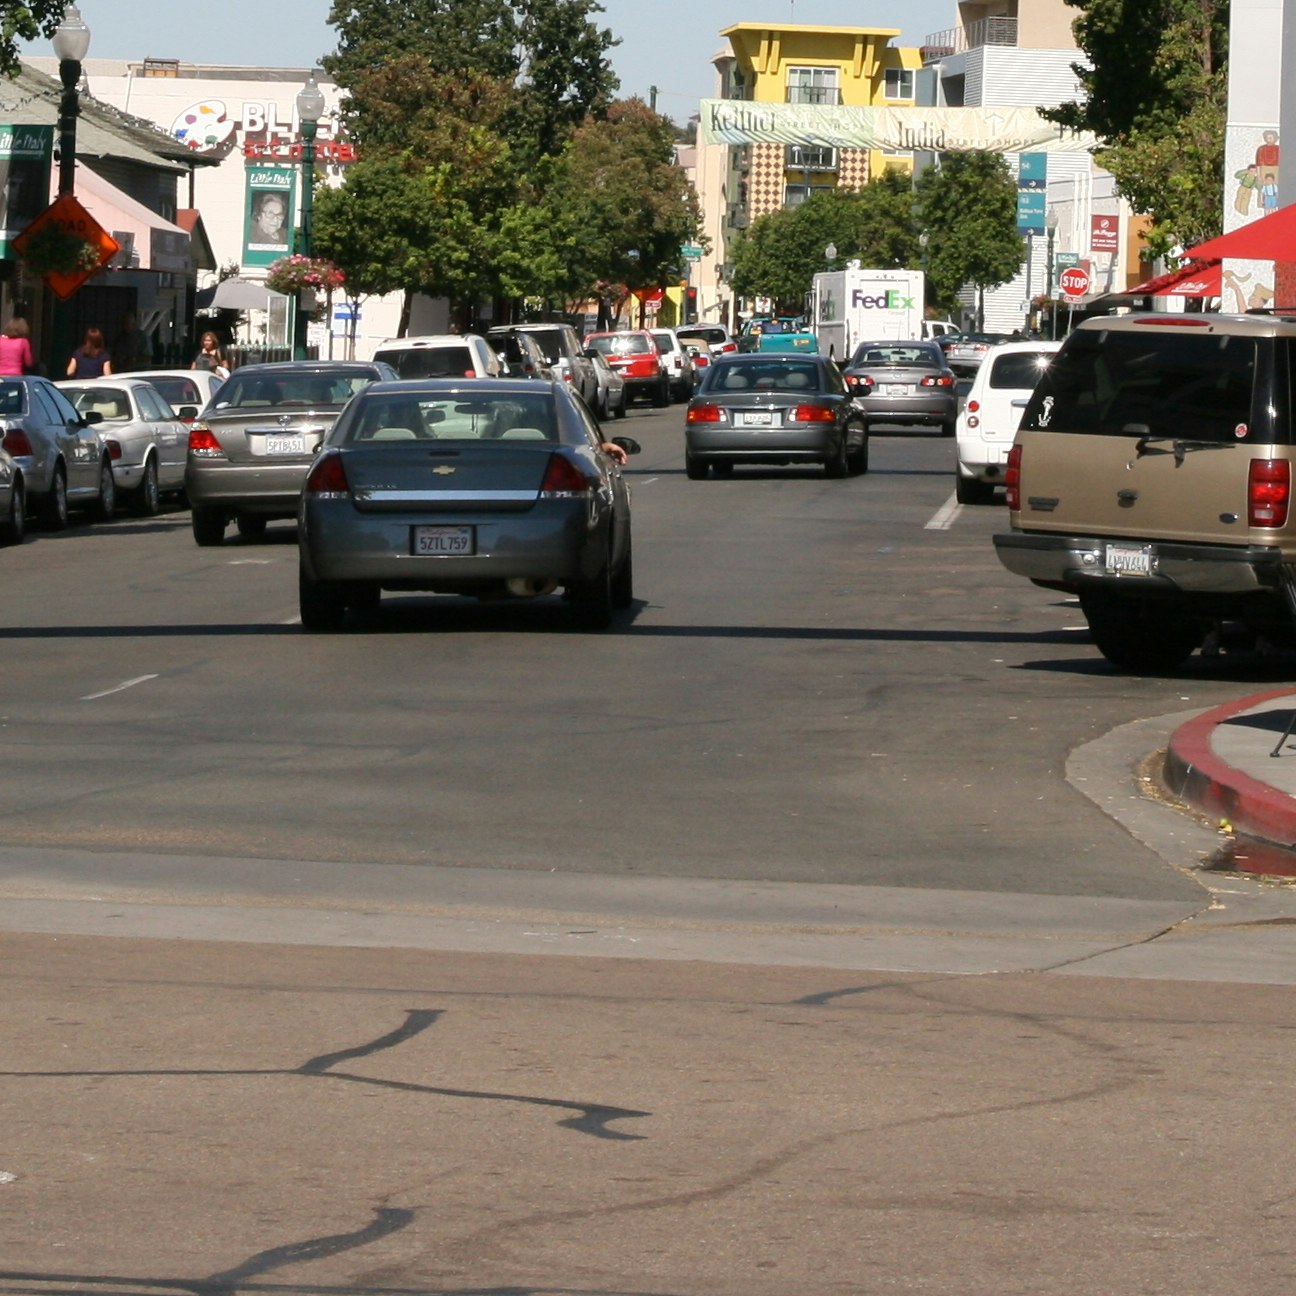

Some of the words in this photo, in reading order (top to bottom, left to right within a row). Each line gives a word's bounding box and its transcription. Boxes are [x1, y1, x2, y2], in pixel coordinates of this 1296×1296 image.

[897, 121, 947, 149] India
[1061, 276, 1088, 289] STOP
[851, 288, 916, 310] FedEx
[419, 536, 469, 551] 5ZTL759
